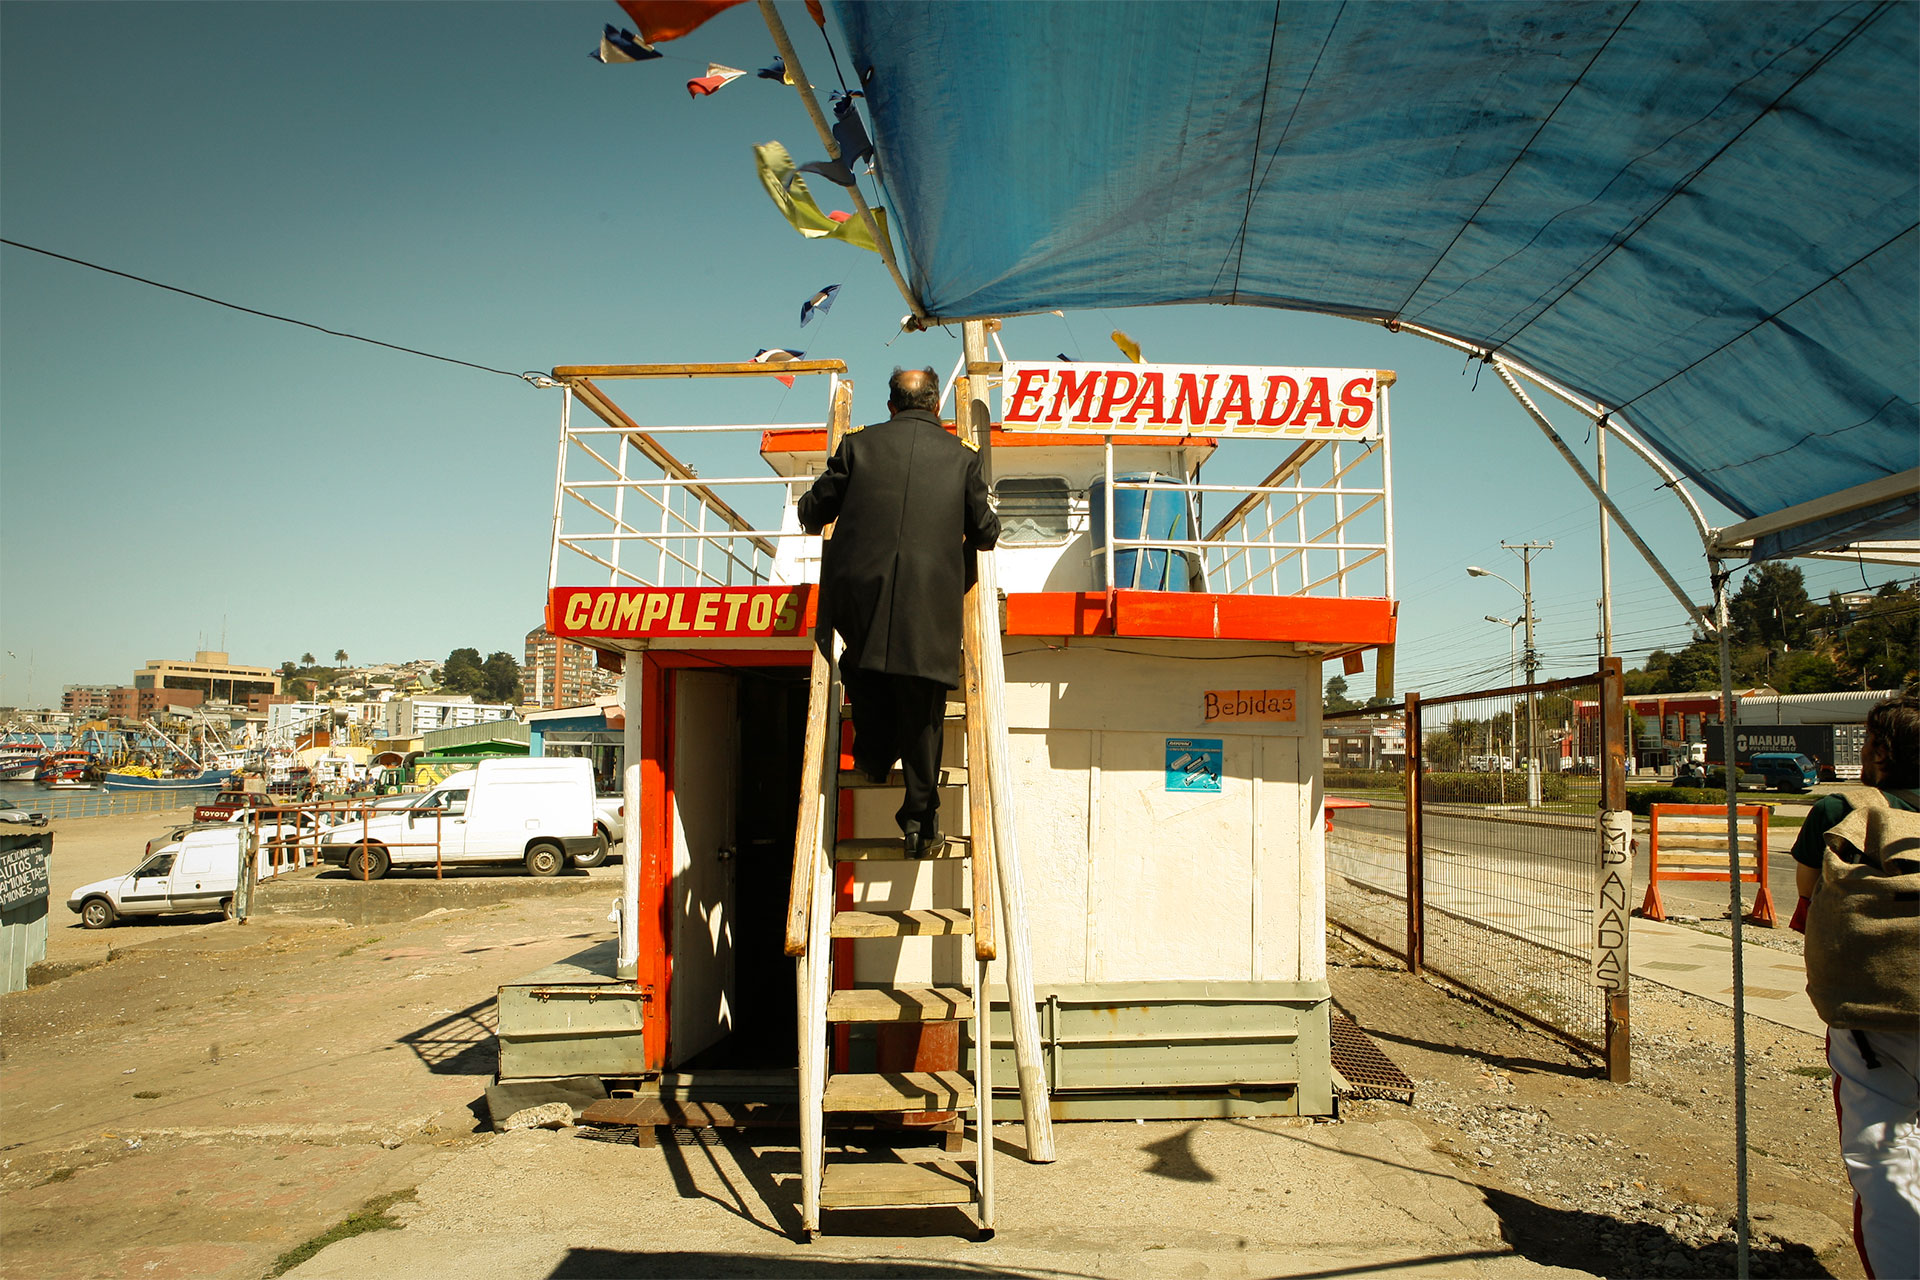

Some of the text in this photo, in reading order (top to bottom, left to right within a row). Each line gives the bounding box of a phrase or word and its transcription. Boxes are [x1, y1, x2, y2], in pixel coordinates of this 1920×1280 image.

[1011, 369, 1376, 432] EMPANADAS
[563, 590, 803, 636] COMPLETOS
[1204, 690, 1293, 720] Bebidas
[1749, 735, 1796, 746] MARUBA
[1596, 809, 1627, 991] EMPANADAS
